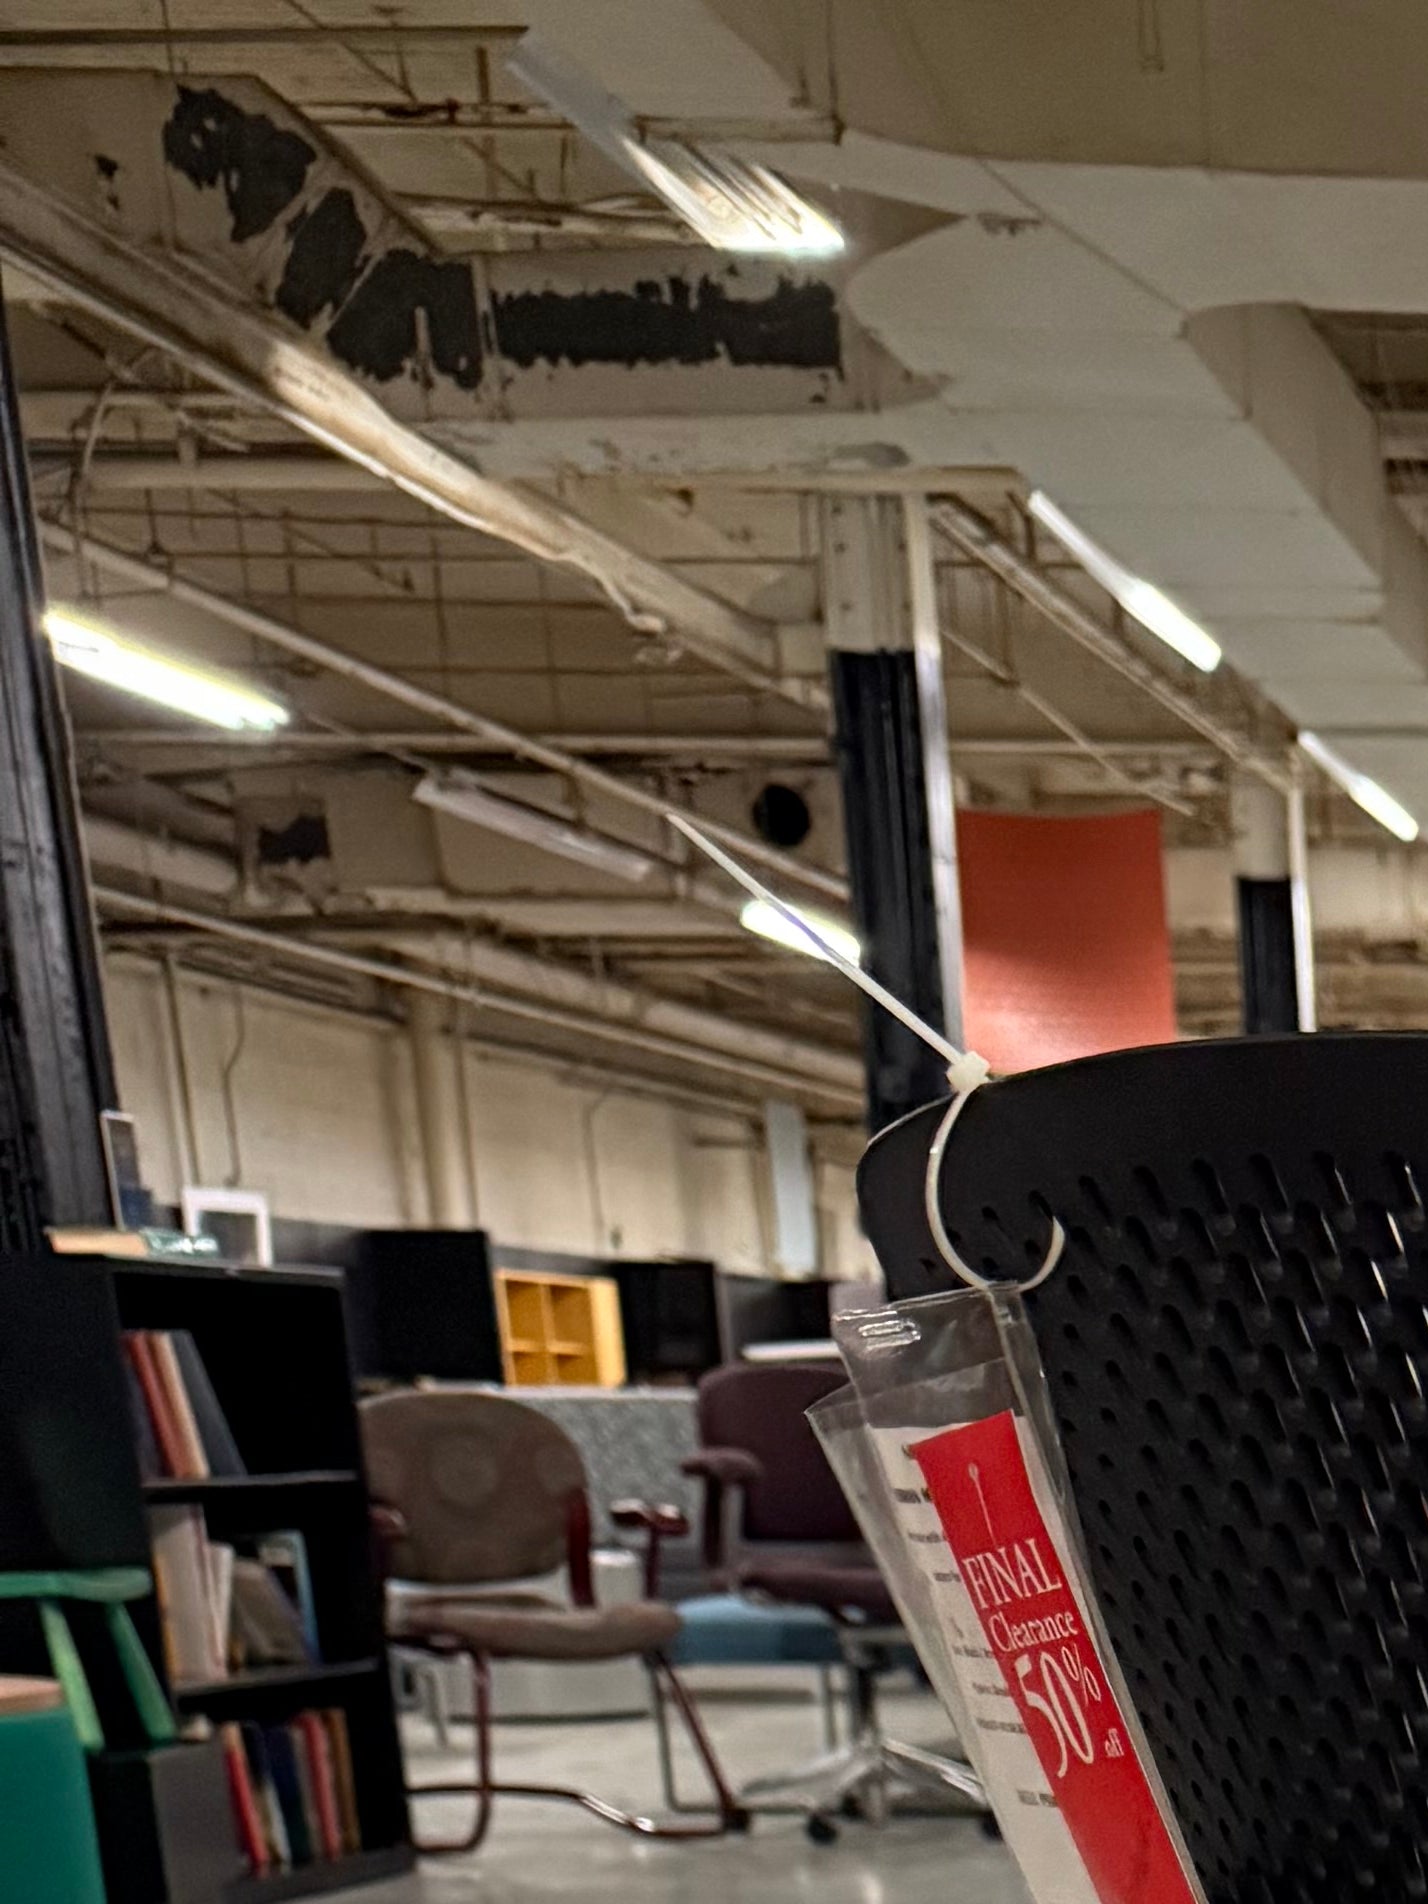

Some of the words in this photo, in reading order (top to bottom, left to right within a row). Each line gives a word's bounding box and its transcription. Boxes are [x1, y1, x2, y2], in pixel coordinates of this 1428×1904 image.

[963, 1538, 1062, 1609] FINAL
[988, 1611, 1078, 1652] Clearance
[1105, 1728, 1124, 1757] off
